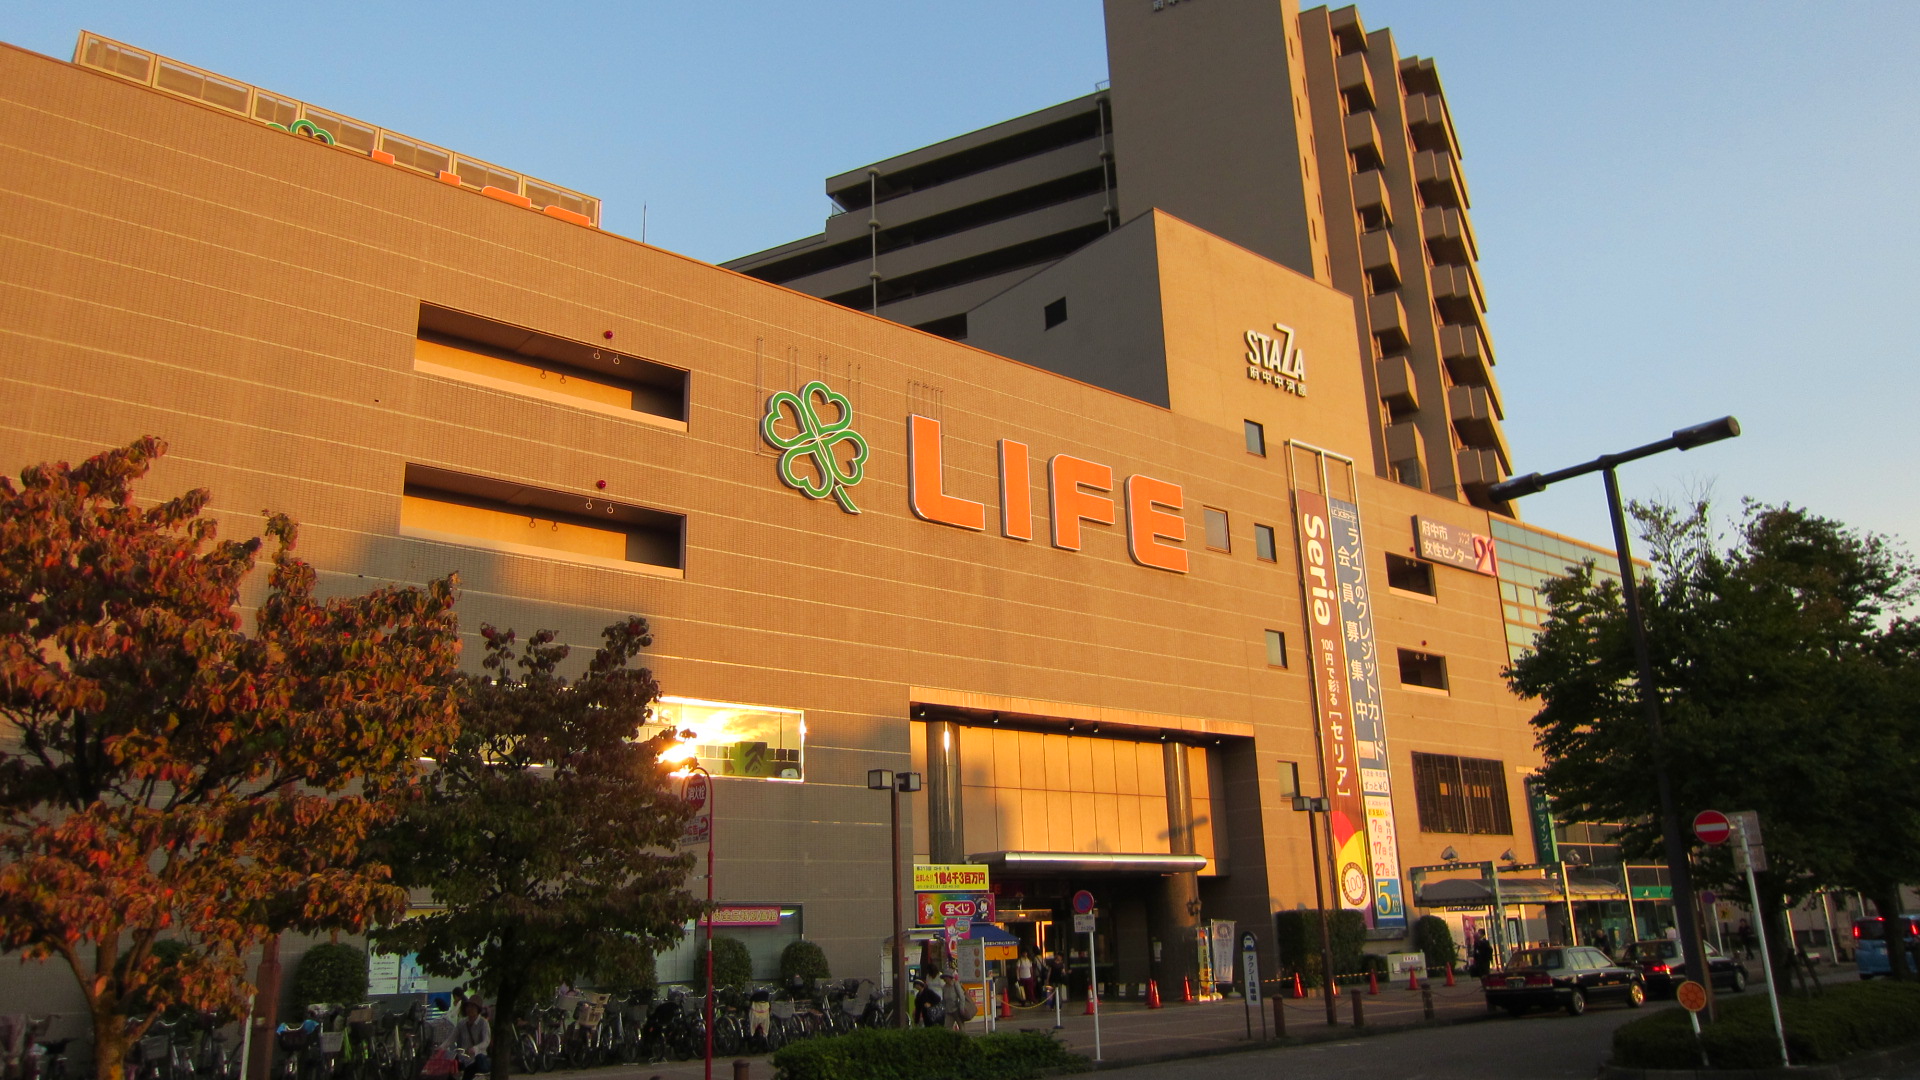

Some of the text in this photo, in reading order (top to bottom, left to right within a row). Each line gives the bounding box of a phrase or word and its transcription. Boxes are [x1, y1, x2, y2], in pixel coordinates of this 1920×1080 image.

[1244, 322, 1305, 382] STAZA
[908, 413, 1189, 574] LIFE
[1421, 520, 1448, 540] 府中市
[1423, 540, 1473, 563] 女性センター
[1303, 512, 1336, 626] Seria
[1347, 527, 1384, 761] ライフのクレジットカード
[944, 903, 970, 915] 宝くじ
